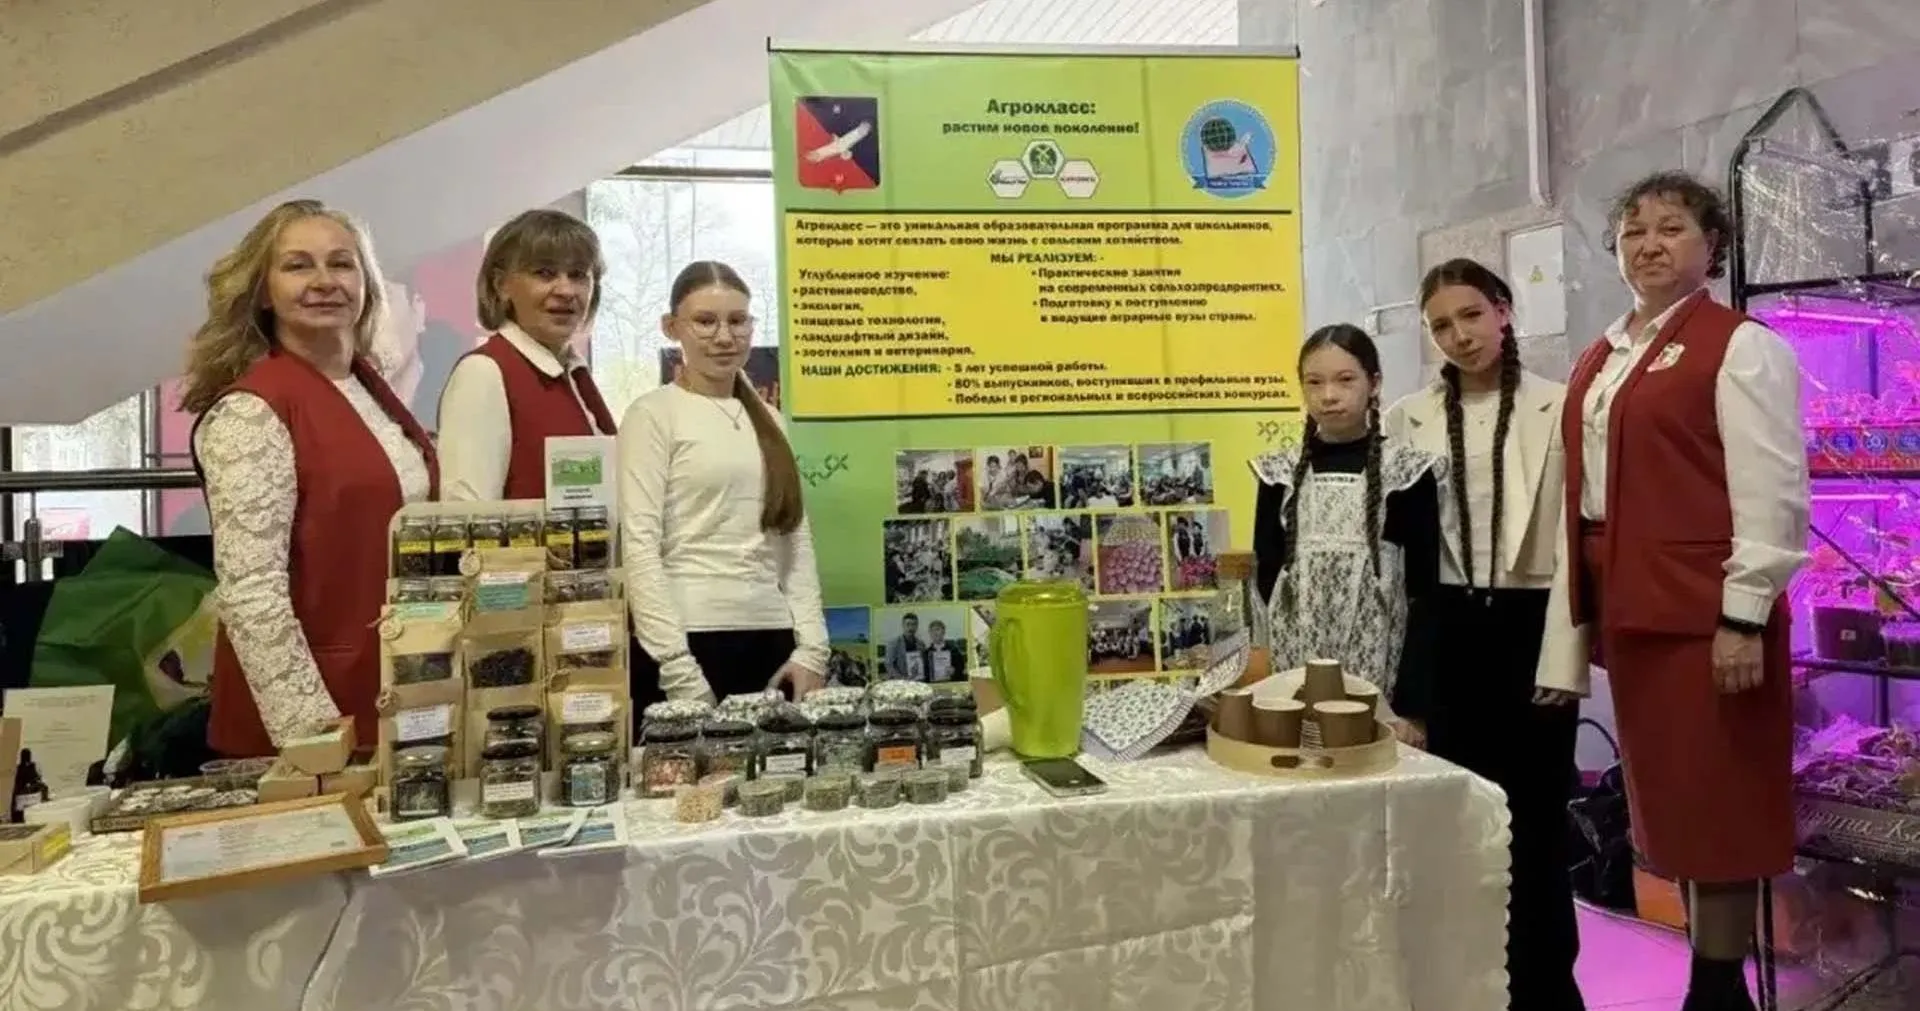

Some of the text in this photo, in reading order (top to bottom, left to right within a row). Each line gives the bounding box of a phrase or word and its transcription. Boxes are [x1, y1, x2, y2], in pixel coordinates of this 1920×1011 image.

[986, 98, 1095, 117] Агрокласс:
[942, 121, 1139, 134] растим новое поколение!
[795, 219, 863, 231] Агрокласс
[880, 222, 901, 230] это
[904, 222, 980, 232] уникальная
[982, 219, 1094, 232] образовательная
[1096, 221, 1168, 232] программа
[1170, 222, 1191, 231] для
[796, 237, 853, 247] которые
[857, 237, 892, 245] хотят
[895, 237, 946, 245] связать
[949, 237, 984, 245] свою
[987, 237, 1028, 245] жизнь
[1041, 237, 1101, 245] сельским
[1017, 252, 1096, 263] РЕАЛИЗУЕМ:
[798, 268, 949, 281] Углубленное изучение:
[1038, 267, 1181, 279] Практические занятия
[1057, 283, 1146, 294] современных
[1039, 297, 1111, 309] Подготовку
[1125, 298, 1207, 308] поступлению
[1050, 314, 1106, 324] ведущие
[1110, 313, 1171, 323] аграрные
[1175, 313, 1206, 322] вузы
[801, 365, 841, 375] НАШИ
[844, 363, 941, 377] ДОСТИЖЕНИЯ:
[965, 364, 985, 373] лет
[989, 361, 1053, 374] успешной
[1076, 377, 1160, 388] поступивших
[1174, 374, 1250, 388] профильные
[955, 393, 1006, 404] Победы
[1020, 393, 1112, 403] региональных
[1126, 388, 1220, 402] всероссийских
